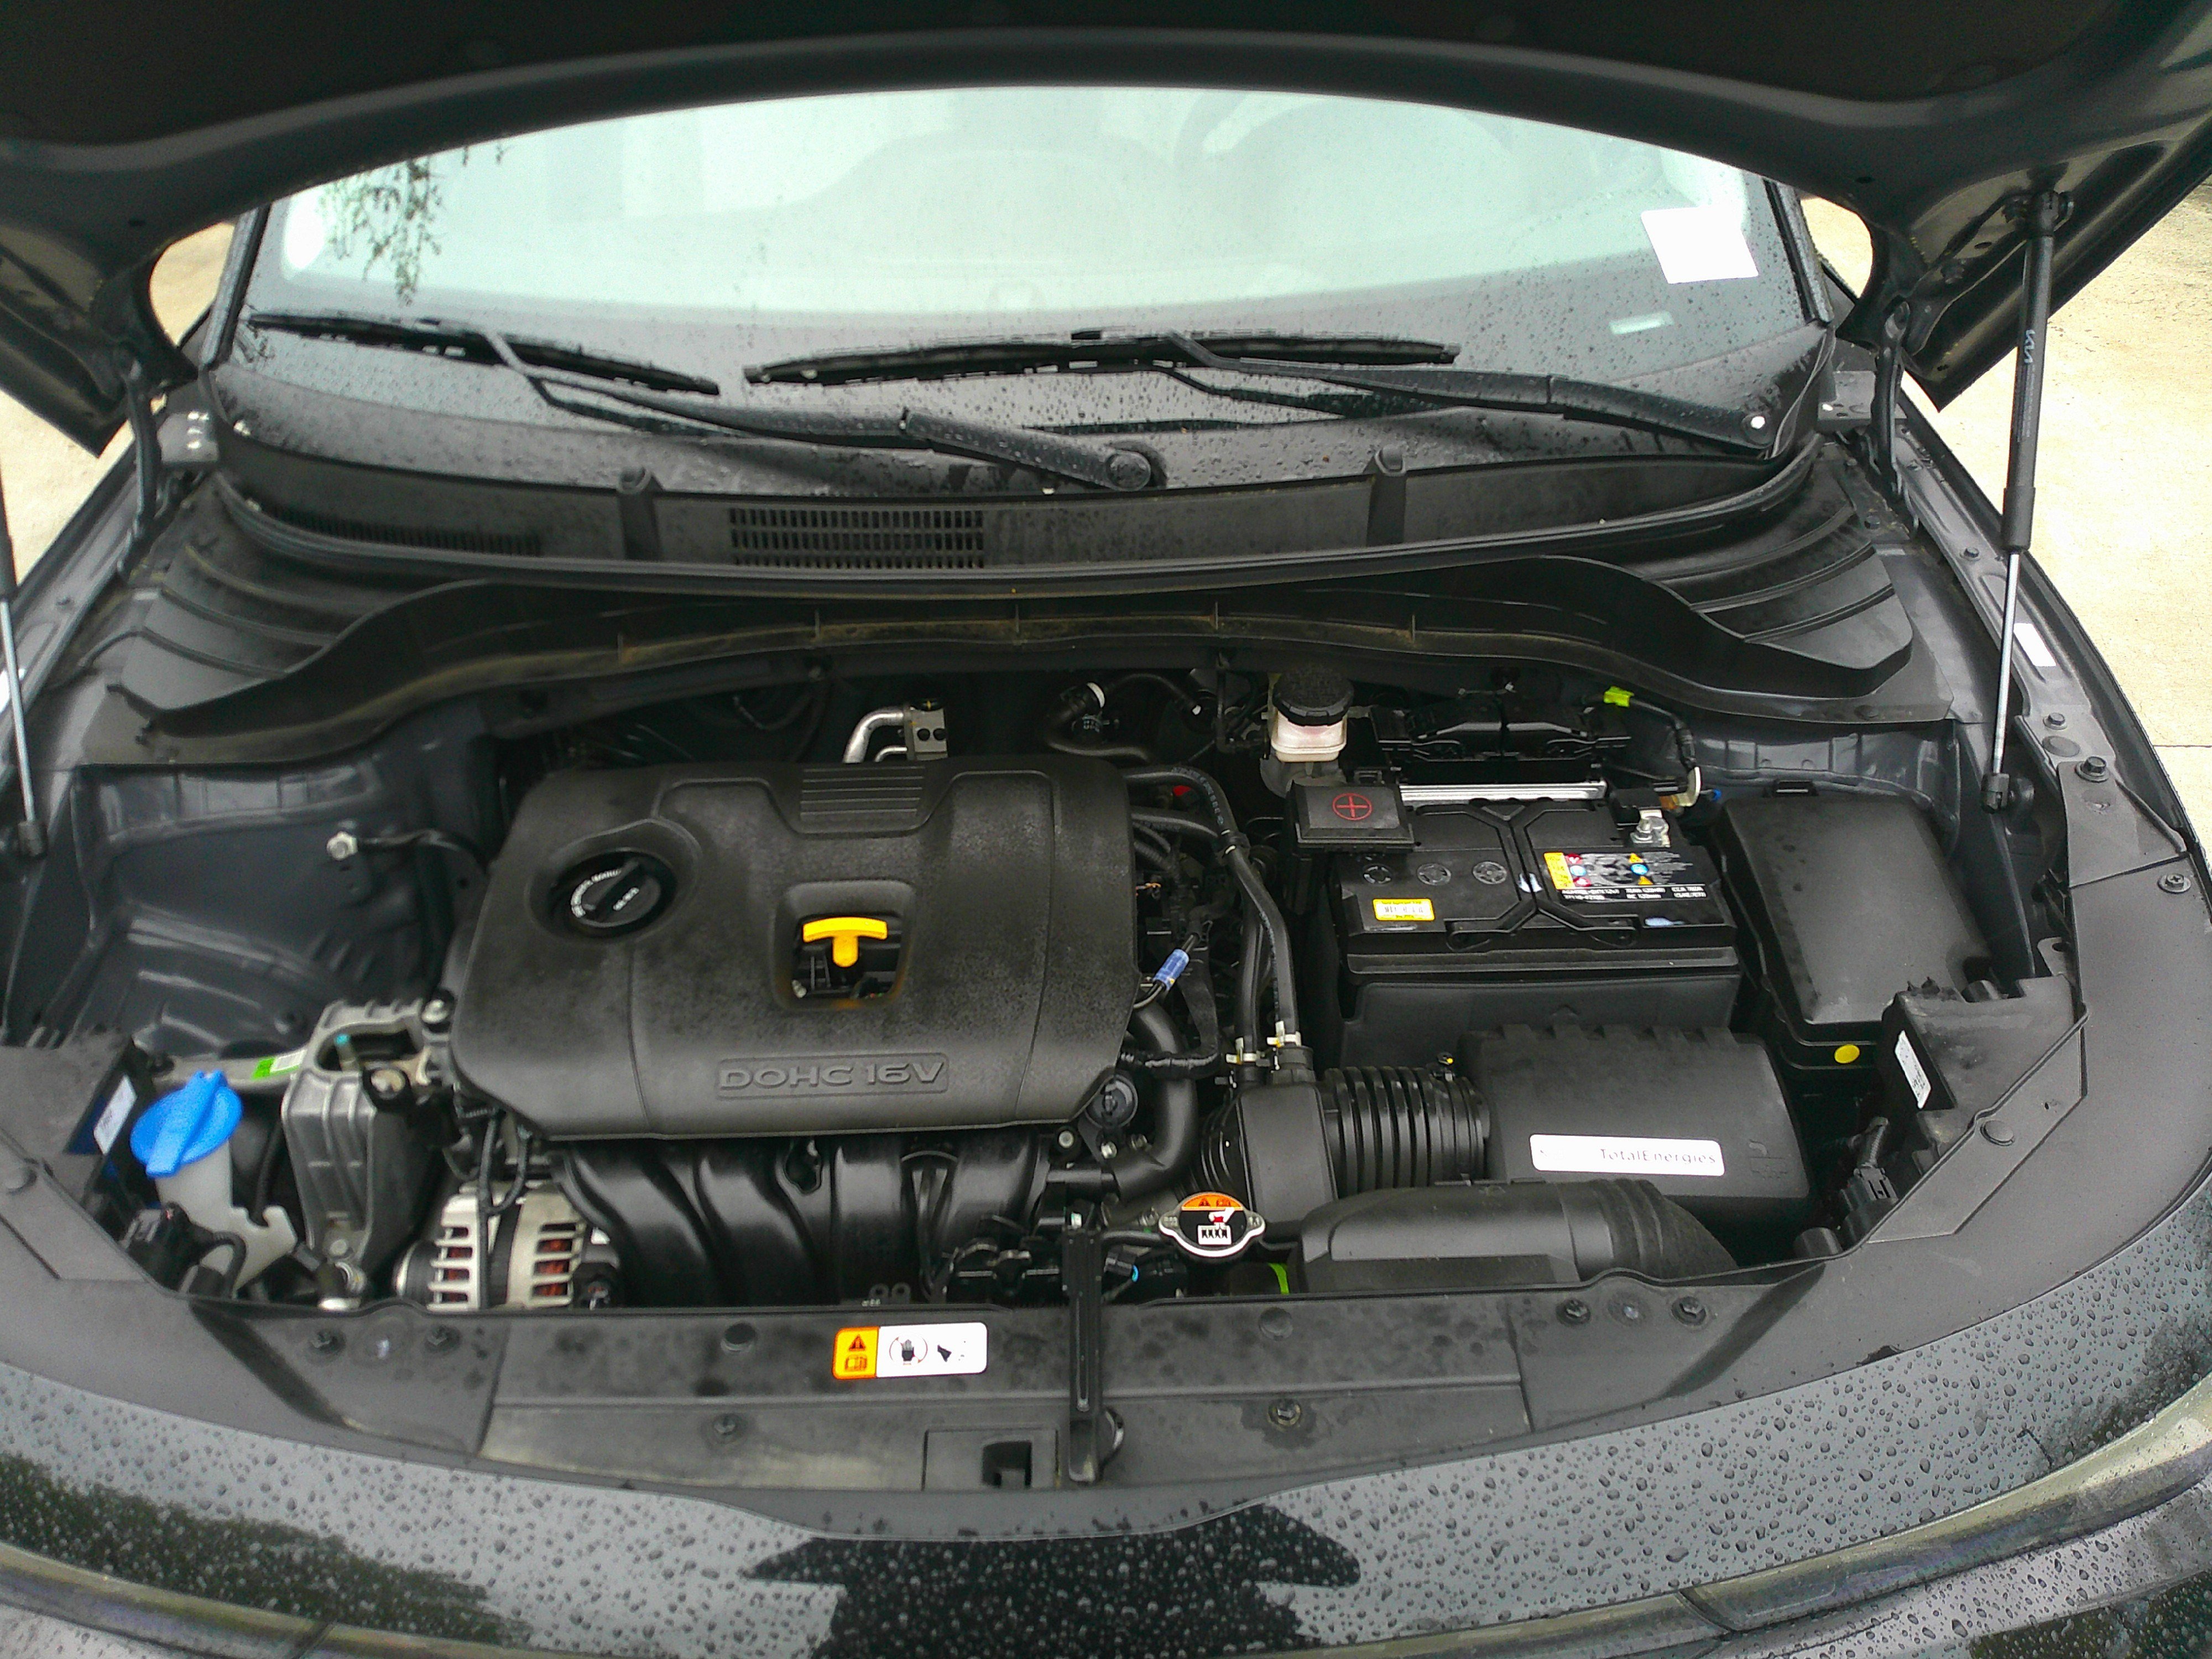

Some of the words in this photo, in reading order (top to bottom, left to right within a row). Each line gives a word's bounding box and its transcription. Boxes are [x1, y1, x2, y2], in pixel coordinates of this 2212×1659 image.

[721, 1063, 854, 1091] DOHC
[867, 1062, 945, 1086] 16V
[1600, 1148, 1716, 1165] TotalEnergies
